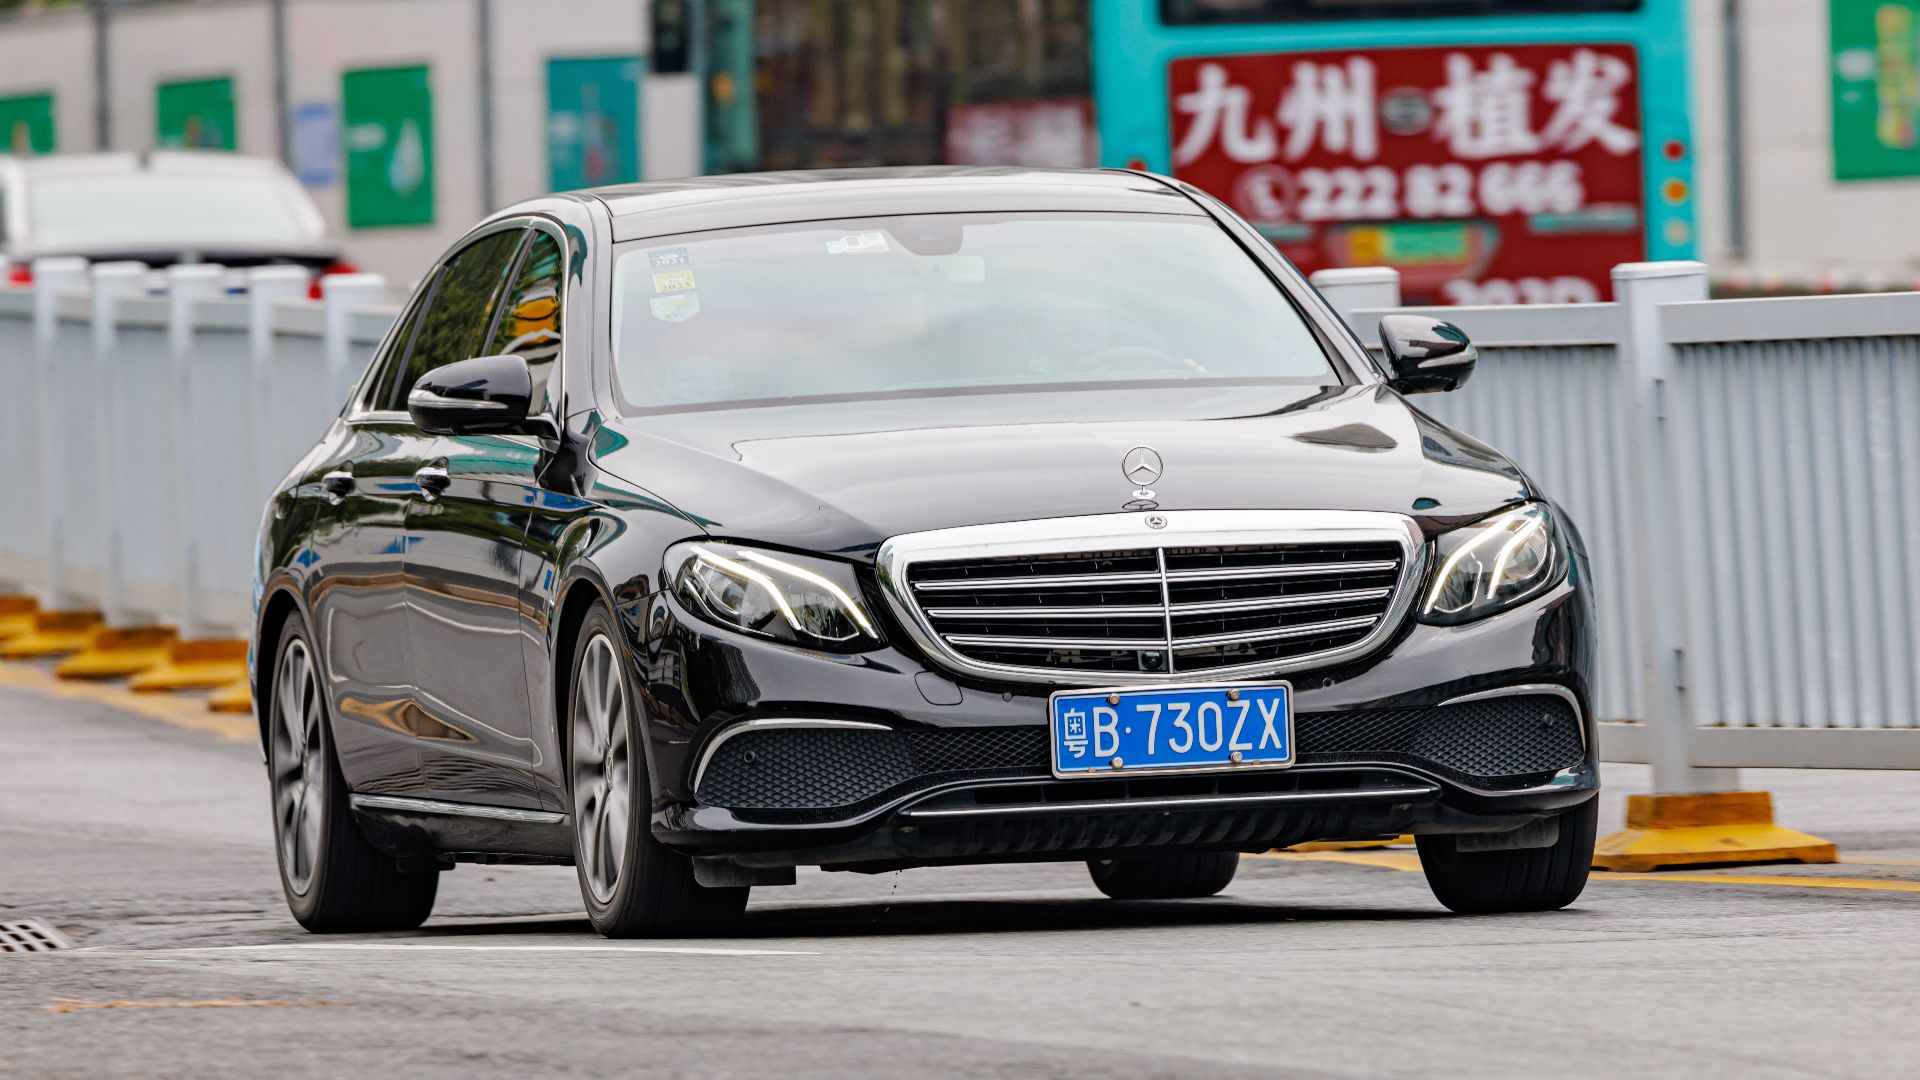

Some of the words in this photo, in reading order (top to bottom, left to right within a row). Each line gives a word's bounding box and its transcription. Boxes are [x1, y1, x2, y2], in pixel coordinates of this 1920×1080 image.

[1173, 56, 1378, 165] 九州
[1432, 48, 1638, 159] 植发
[1298, 167, 1398, 219] 222
[1405, 164, 1473, 217] 82
[1479, 160, 1584, 214] 666
